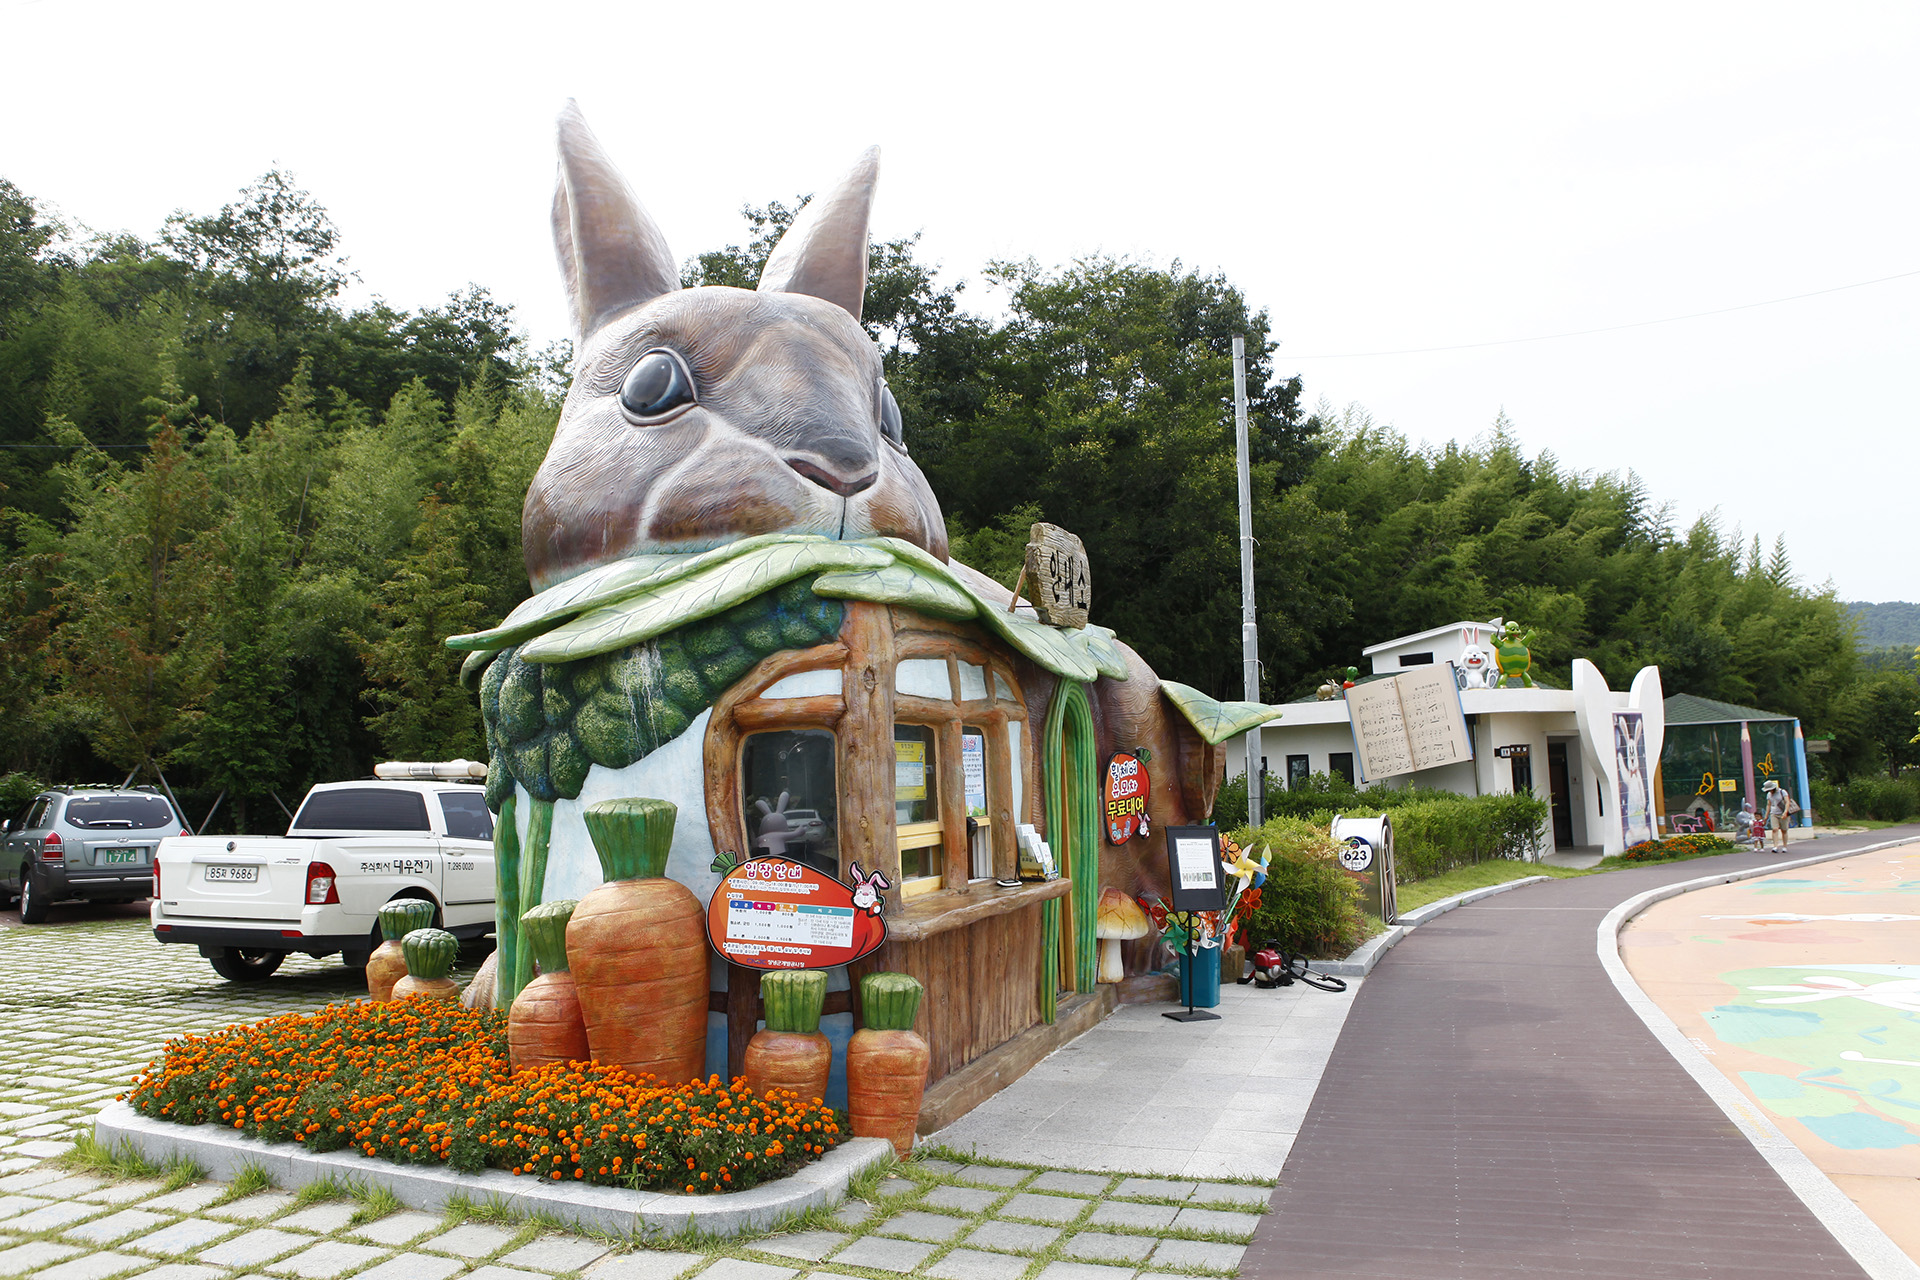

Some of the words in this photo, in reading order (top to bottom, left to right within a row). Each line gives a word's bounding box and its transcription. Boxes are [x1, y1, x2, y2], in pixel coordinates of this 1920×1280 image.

[1111, 760, 1137, 781] 휠체어
[1112, 780, 1138, 798] 유모차
[1107, 796, 1144, 820] 무료대여
[108, 853, 136, 862] 1714
[1344, 850, 1367, 861] 623
[230, 868, 252, 879] 9686
[361, 862, 390, 873] 주식회사
[393, 860, 433, 874] 대우전기
[745, 863, 802, 879] 입장안내
